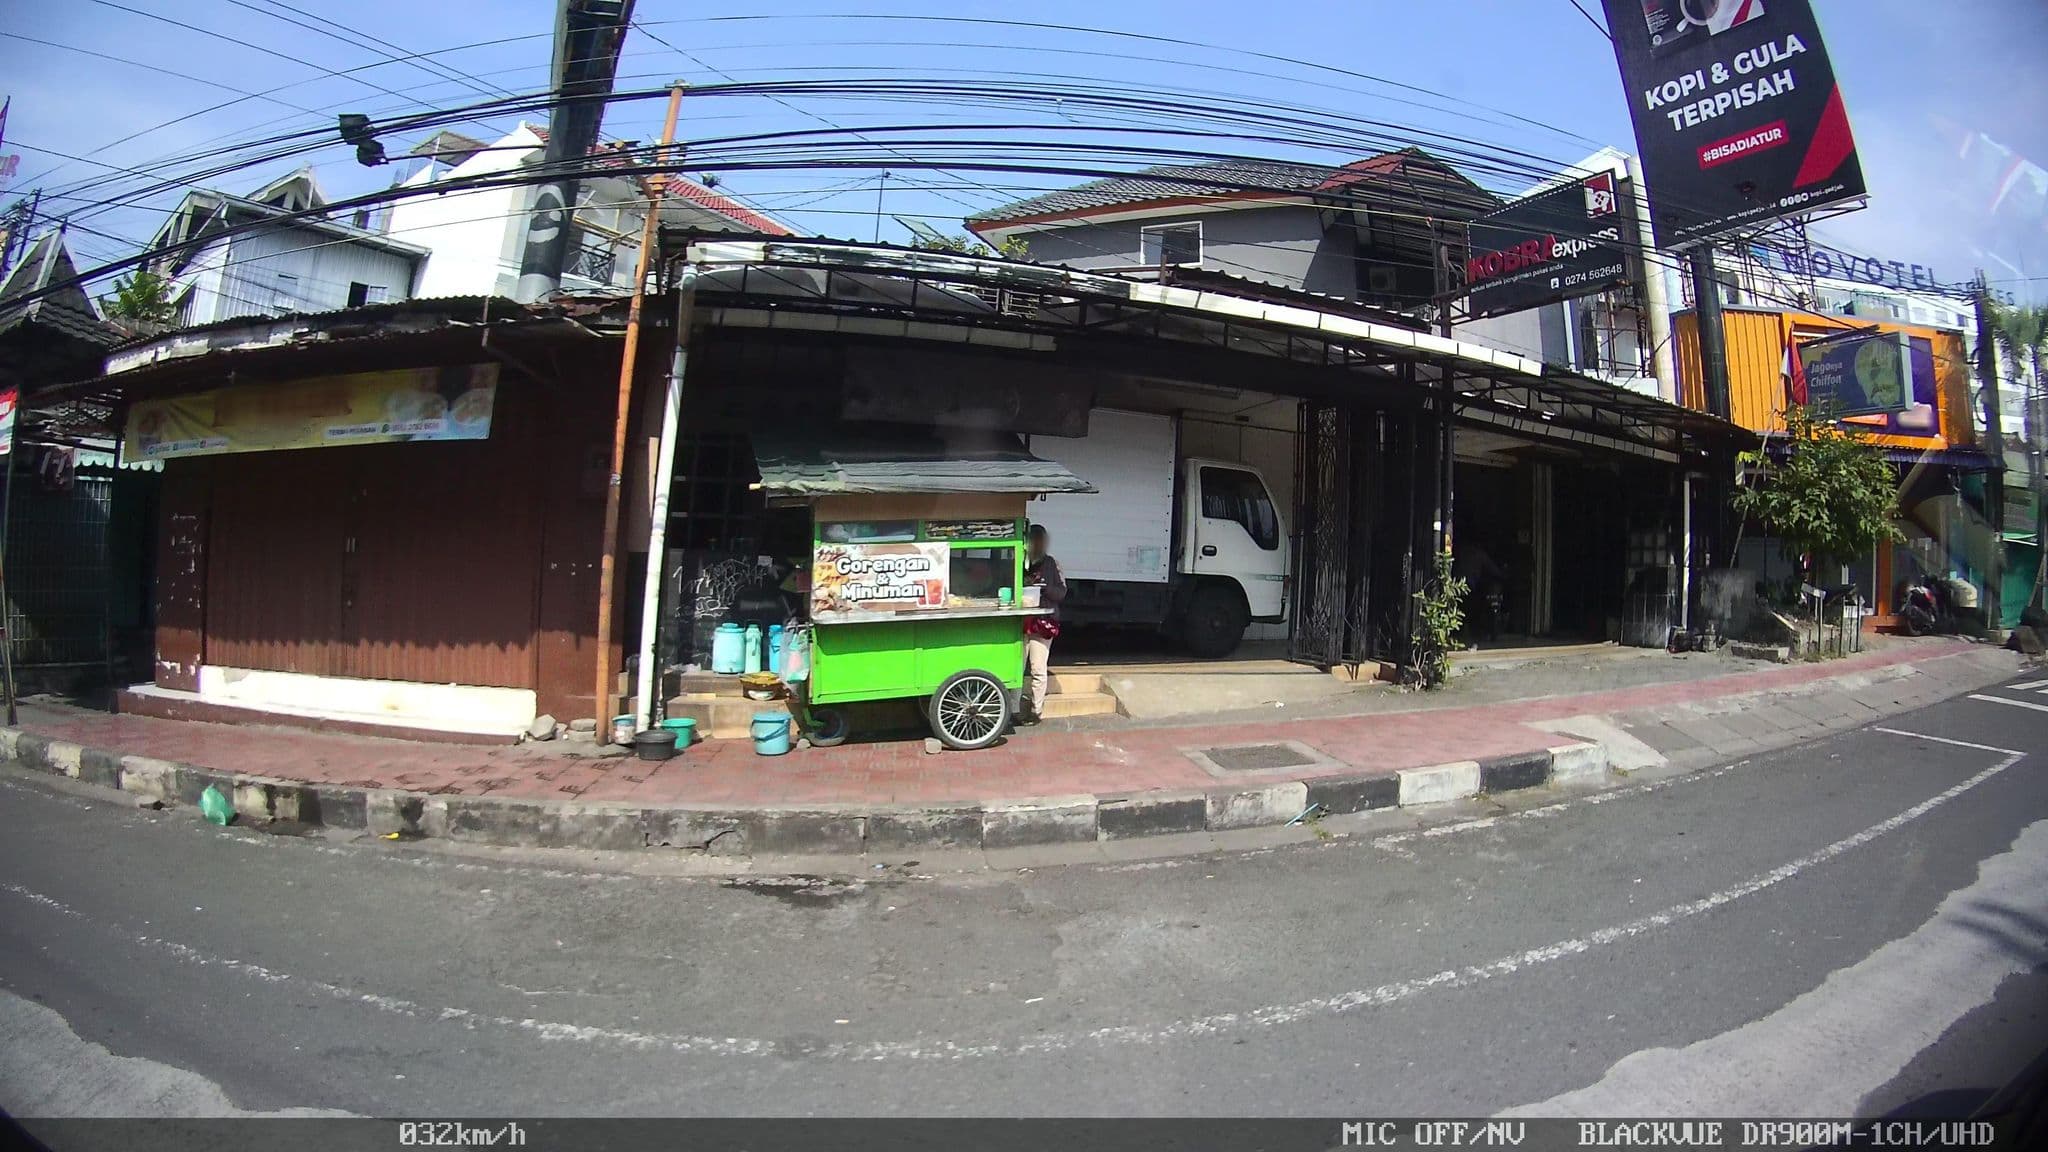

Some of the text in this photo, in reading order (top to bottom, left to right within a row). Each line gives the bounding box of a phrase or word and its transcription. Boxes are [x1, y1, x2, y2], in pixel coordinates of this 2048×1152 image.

[1644, 34, 1807, 110] KOPI & GULA
[1667, 69, 1796, 131] TERPISAH
[1703, 128, 1782, 162] #BISADIATUR
[1467, 234, 1557, 284] KOBRA
[1782, 250, 1936, 288] NOVOTEL
[1565, 264, 1623, 286] 0274 562648
[1810, 374, 1842, 387] Chiffon
[836, 556, 930, 576] Gorengan
[876, 572, 890, 585] &
[841, 583, 924, 602] Minuman
